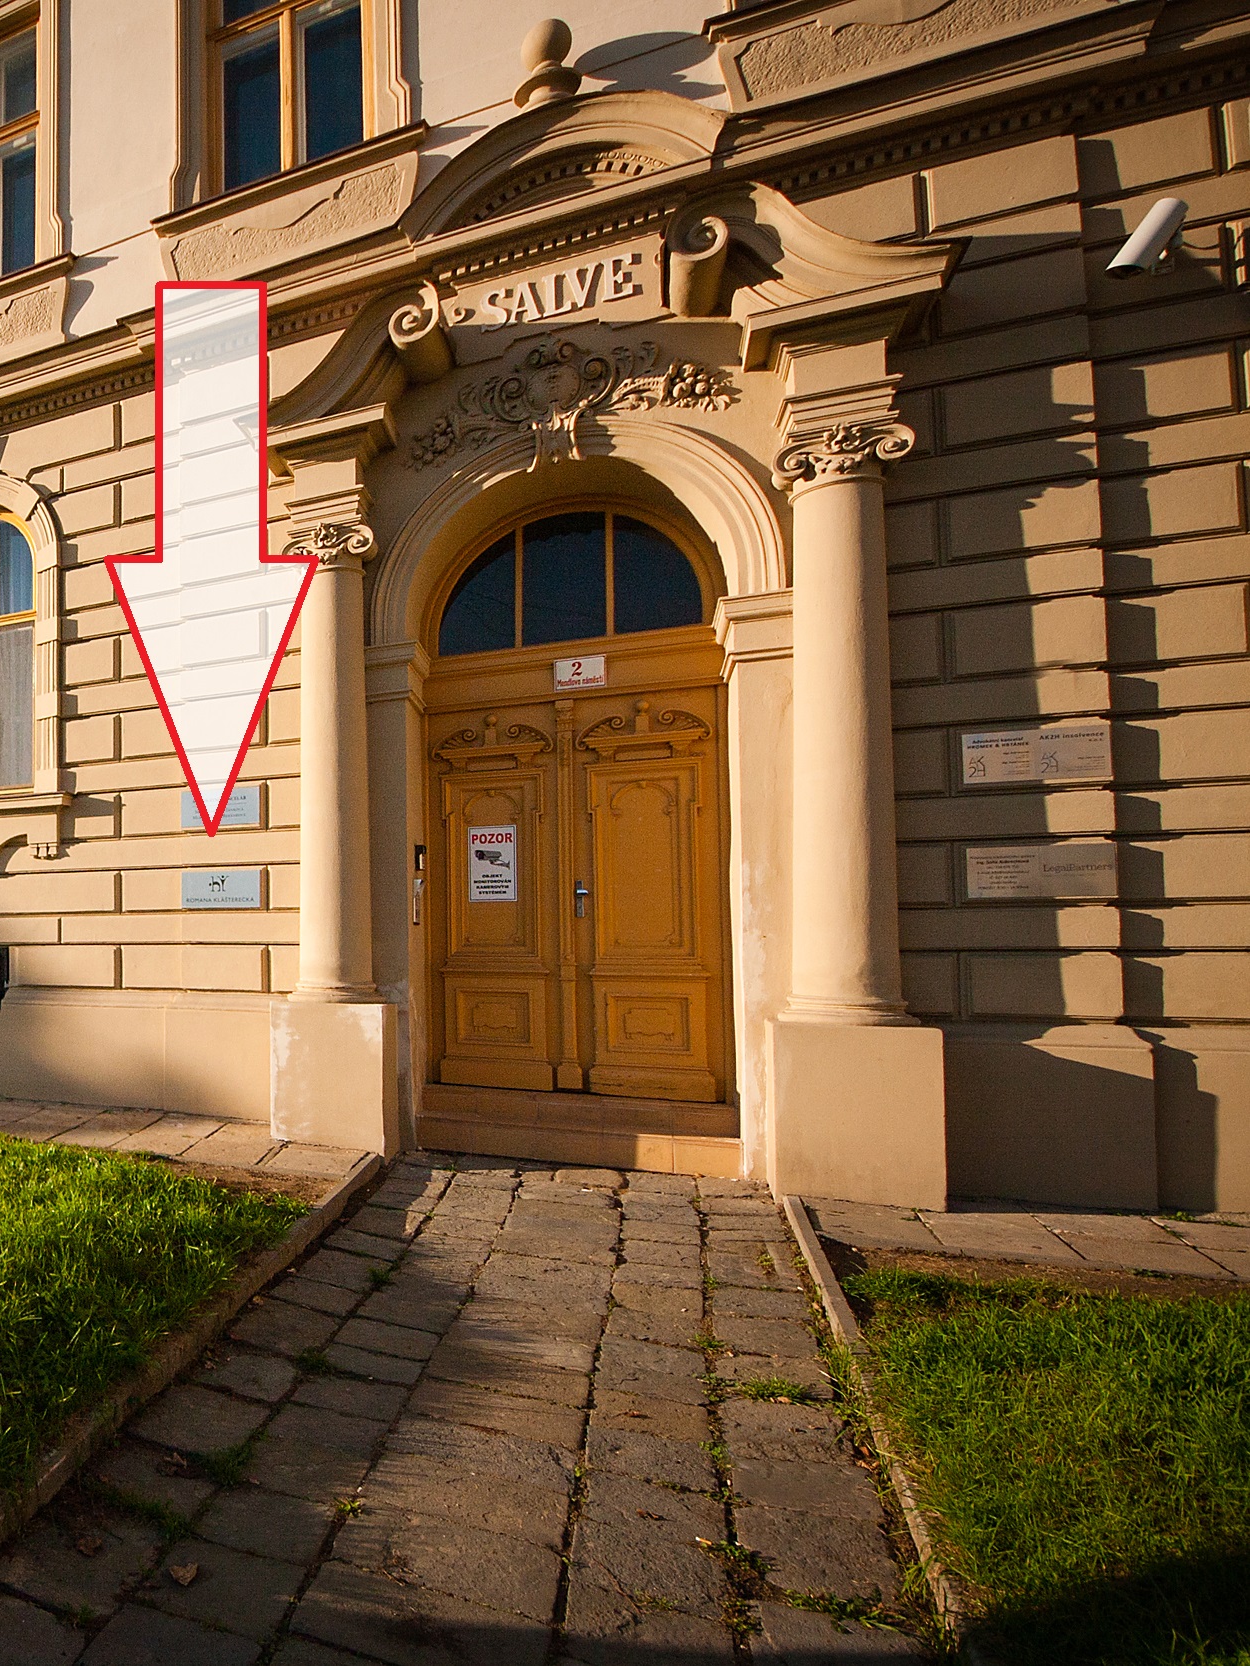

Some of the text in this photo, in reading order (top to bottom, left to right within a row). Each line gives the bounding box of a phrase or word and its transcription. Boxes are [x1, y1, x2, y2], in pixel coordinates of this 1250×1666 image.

[480, 251, 634, 333] SALVE
[571, 661, 583, 677] 2
[471, 832, 513, 845] POZOR
[1042, 863, 1113, 874] LegalPartners
